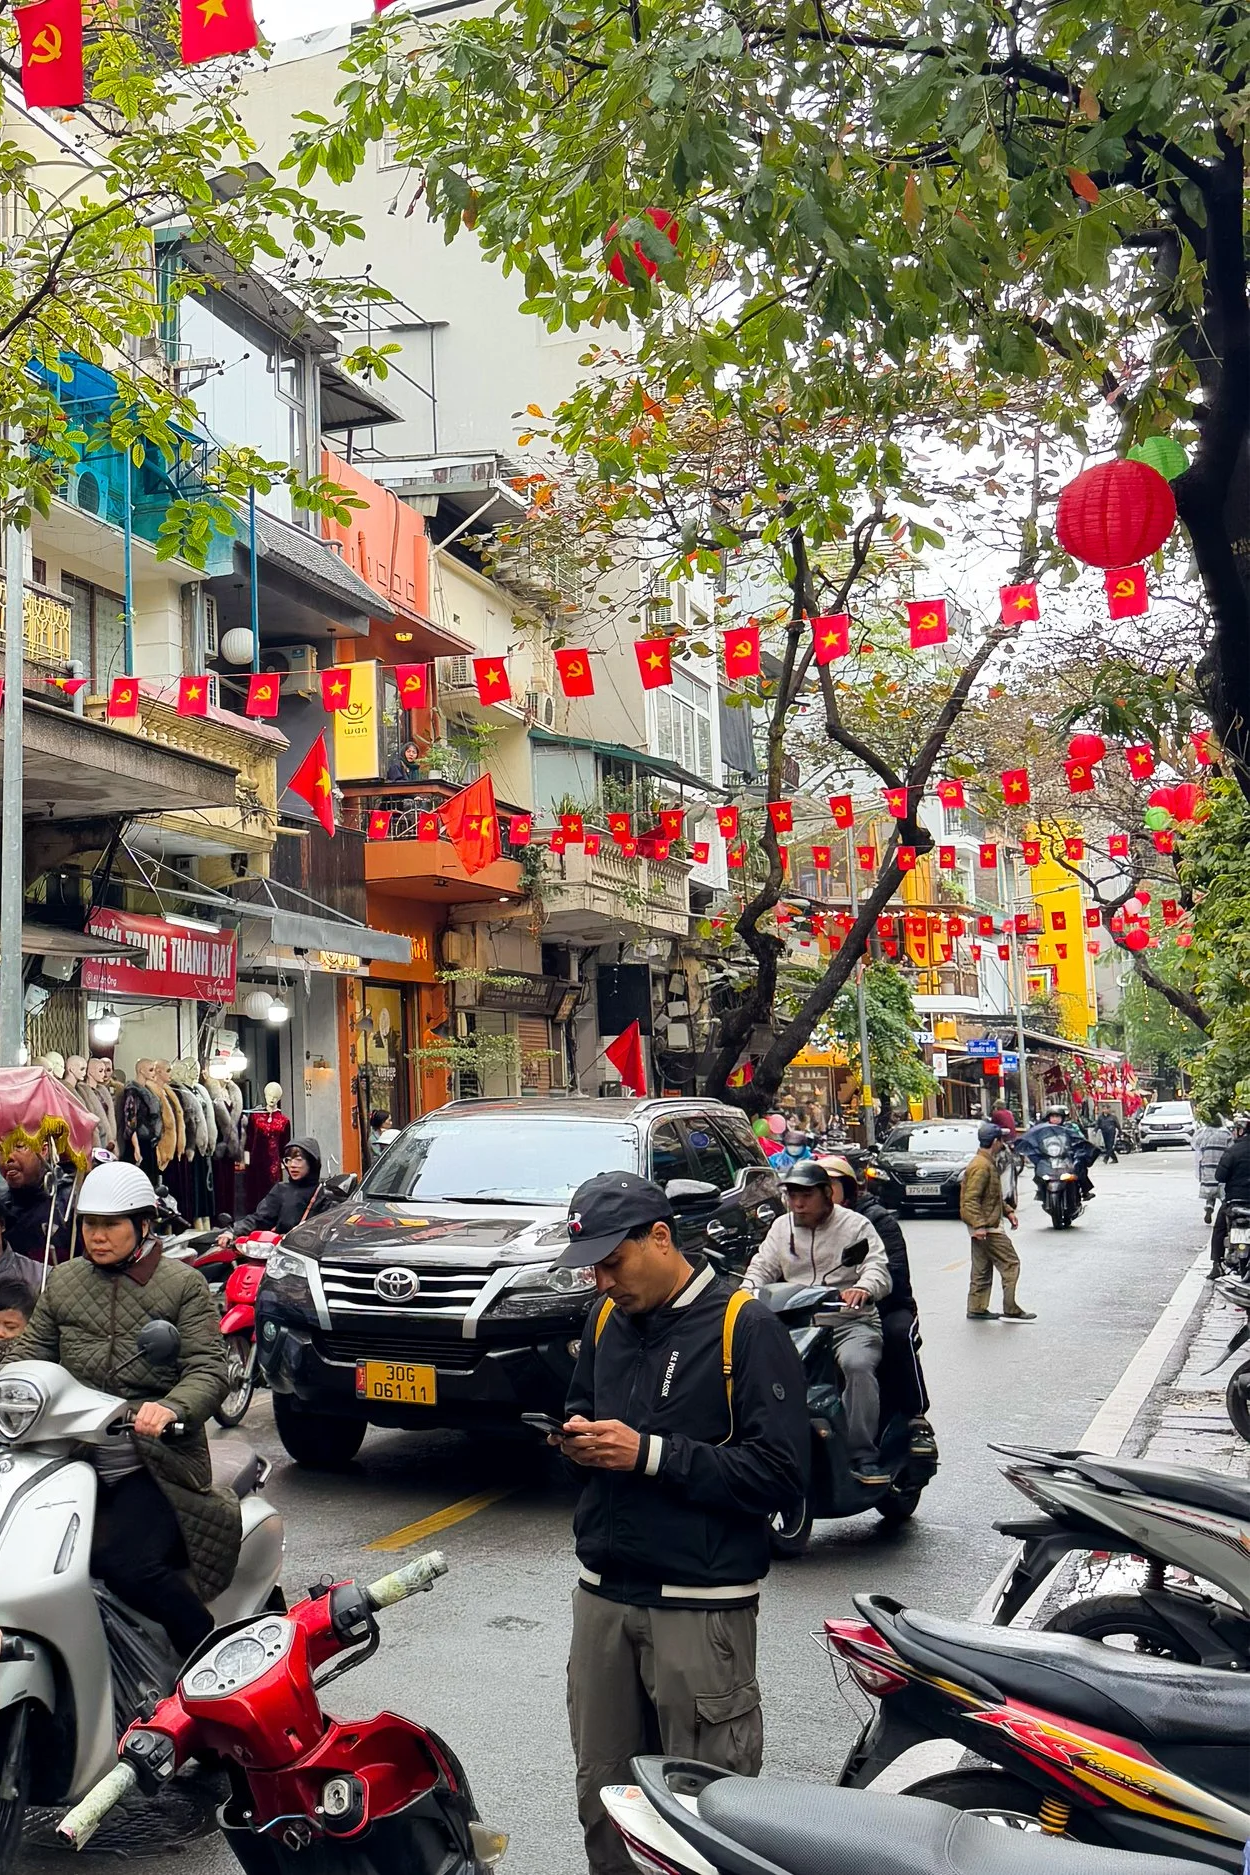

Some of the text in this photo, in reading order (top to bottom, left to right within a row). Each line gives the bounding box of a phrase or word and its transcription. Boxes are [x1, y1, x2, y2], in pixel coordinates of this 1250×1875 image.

[170, 931, 209, 976] THÀNH
[211, 943, 234, 986] ĐẠT
[385, 1365, 415, 1383] 30G
[665, 1361, 677, 1379] POLO
[374, 1382, 427, 1402] 061.11
